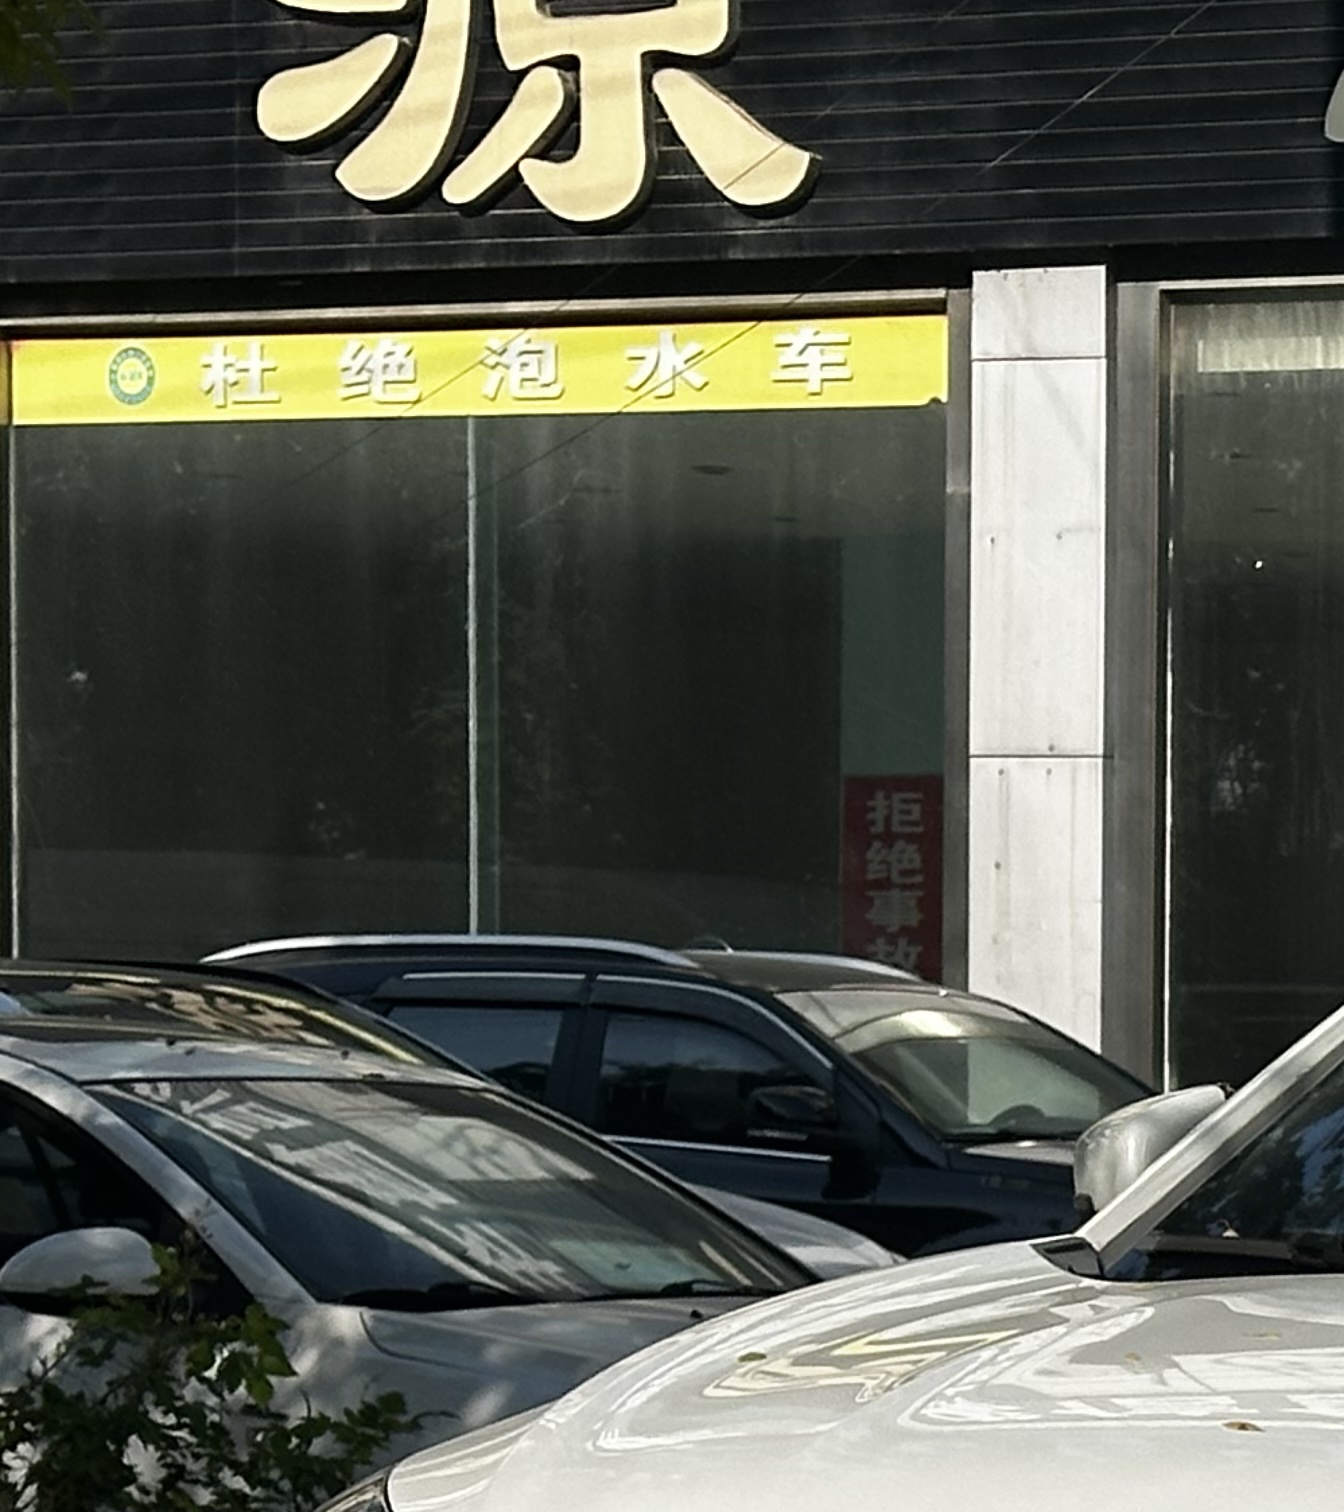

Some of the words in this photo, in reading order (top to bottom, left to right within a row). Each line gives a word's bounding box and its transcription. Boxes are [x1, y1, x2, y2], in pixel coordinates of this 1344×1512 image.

[200, 328, 853, 408] 杜绝泡水车
